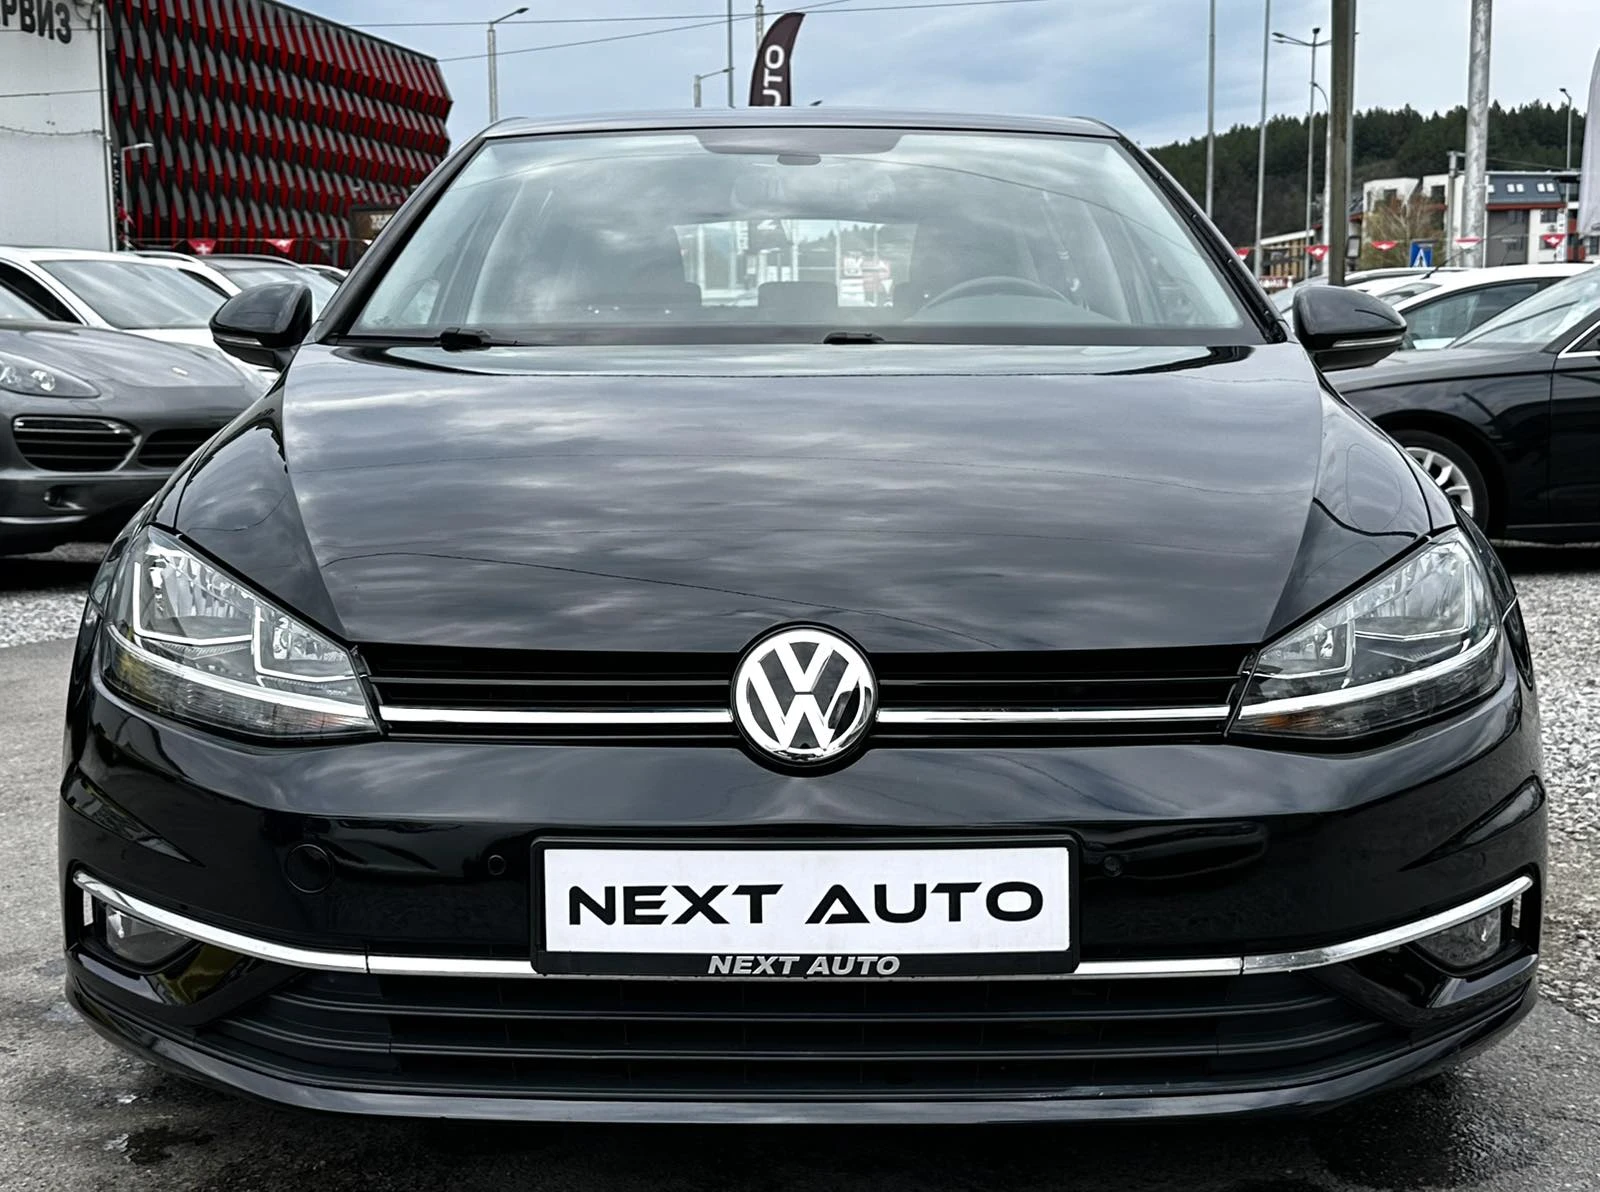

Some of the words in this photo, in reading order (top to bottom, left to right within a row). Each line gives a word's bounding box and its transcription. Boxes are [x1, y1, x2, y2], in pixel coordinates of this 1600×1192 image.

[568, 884, 784, 926] NEXT
[804, 881, 1044, 925] AUTO
[707, 955, 801, 975] NEXT
[806, 956, 901, 976] AUTO
